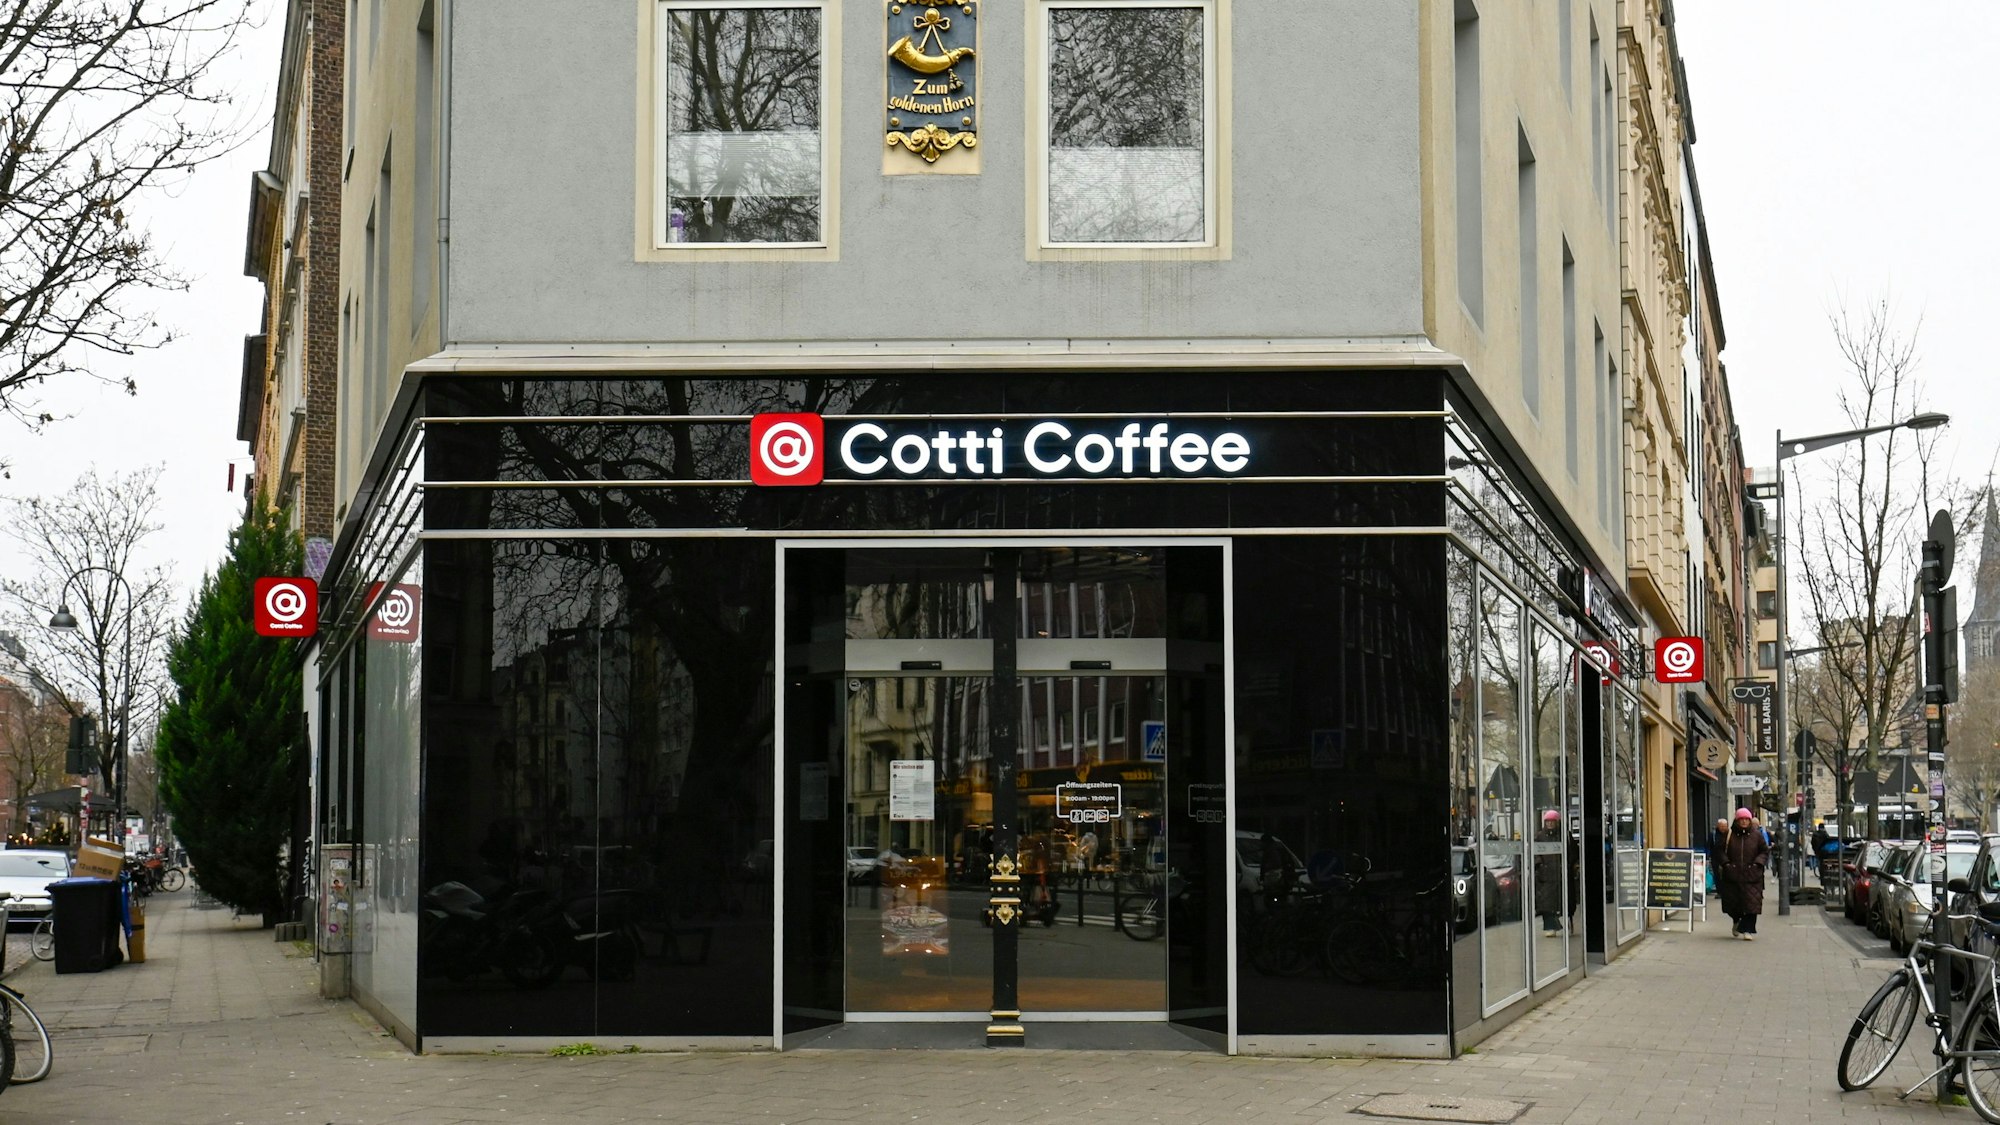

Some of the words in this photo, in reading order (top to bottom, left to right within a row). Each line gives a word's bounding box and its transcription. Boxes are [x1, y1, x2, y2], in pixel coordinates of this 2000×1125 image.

[912, 79, 948, 94] Zum
[888, 95, 942, 113] goldenen
[943, 96, 975, 113] Horn
[840, 423, 1004, 474] Cotti
[1024, 422, 1250, 474] Coffee
[1763, 725, 1771, 734] IL
[1065, 781, 1113, 789] Öffnungszeiten
